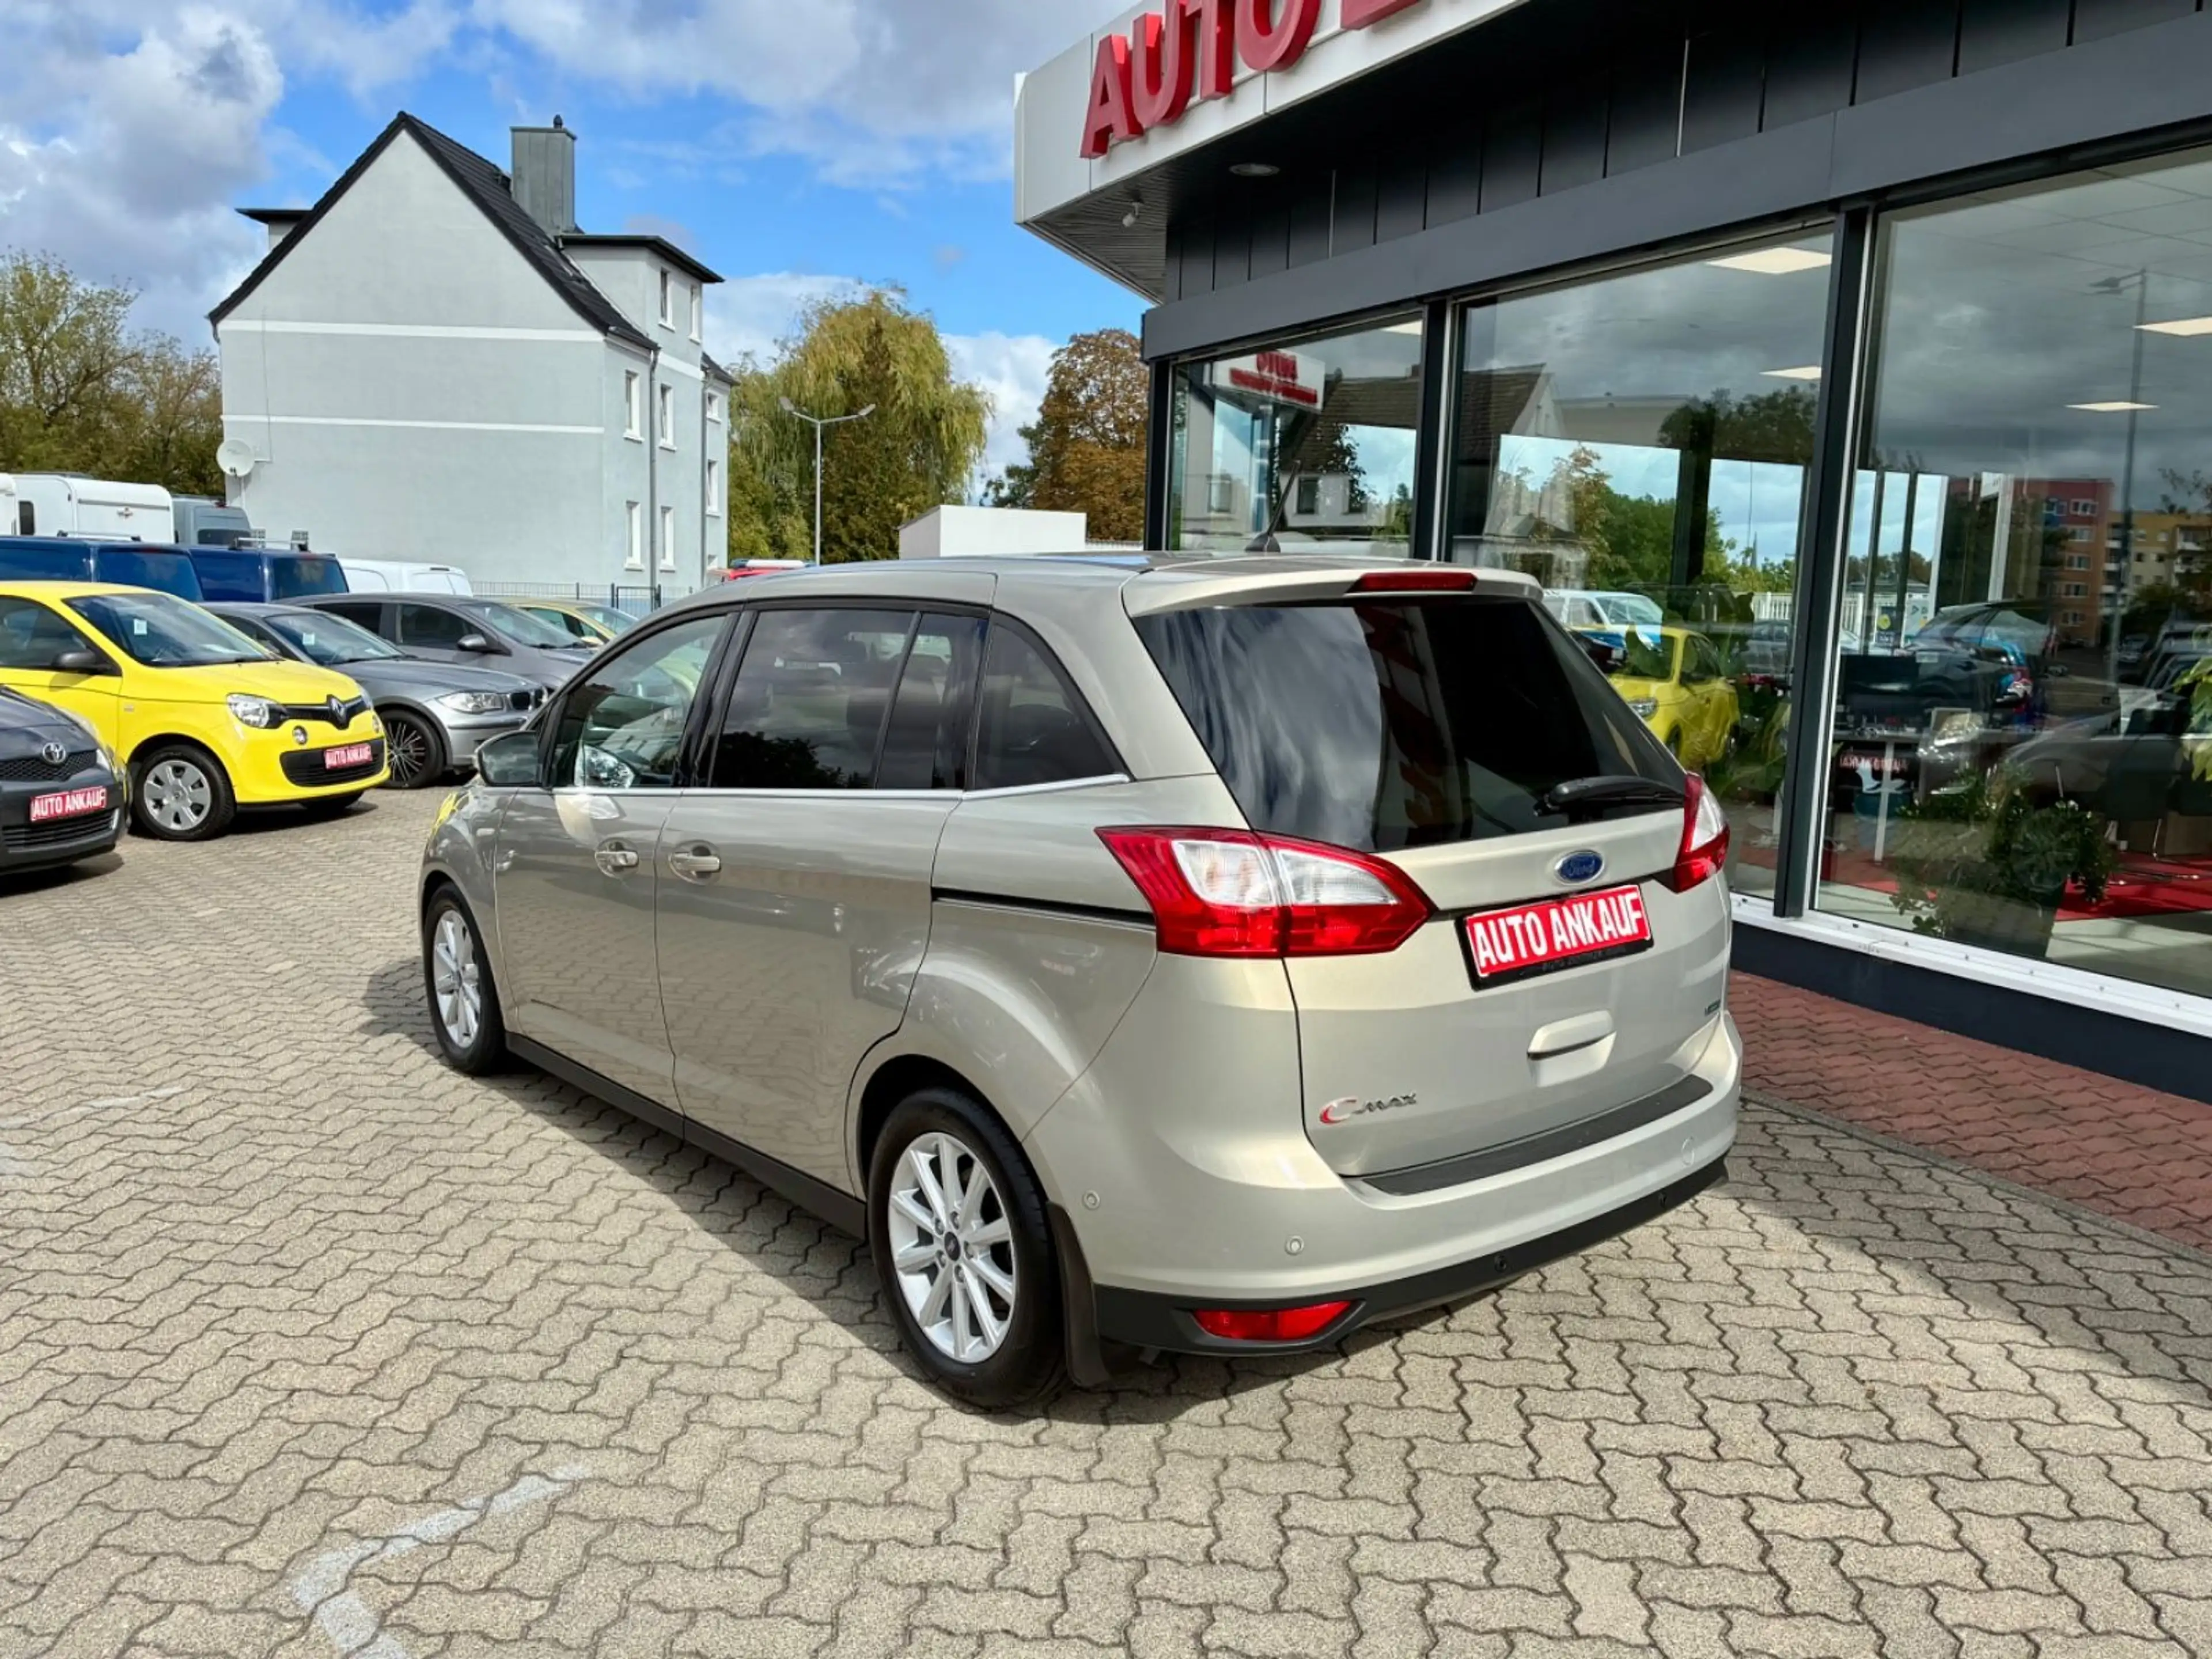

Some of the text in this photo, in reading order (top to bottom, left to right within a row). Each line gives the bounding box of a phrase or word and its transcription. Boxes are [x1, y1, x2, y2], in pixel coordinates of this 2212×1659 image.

[1080, 0, 1320, 159] AUTO
[34, 788, 106, 817] AUTO ANKAUF
[1472, 911, 1548, 968] AUTO
[1549, 892, 1643, 952] ANKAUF
